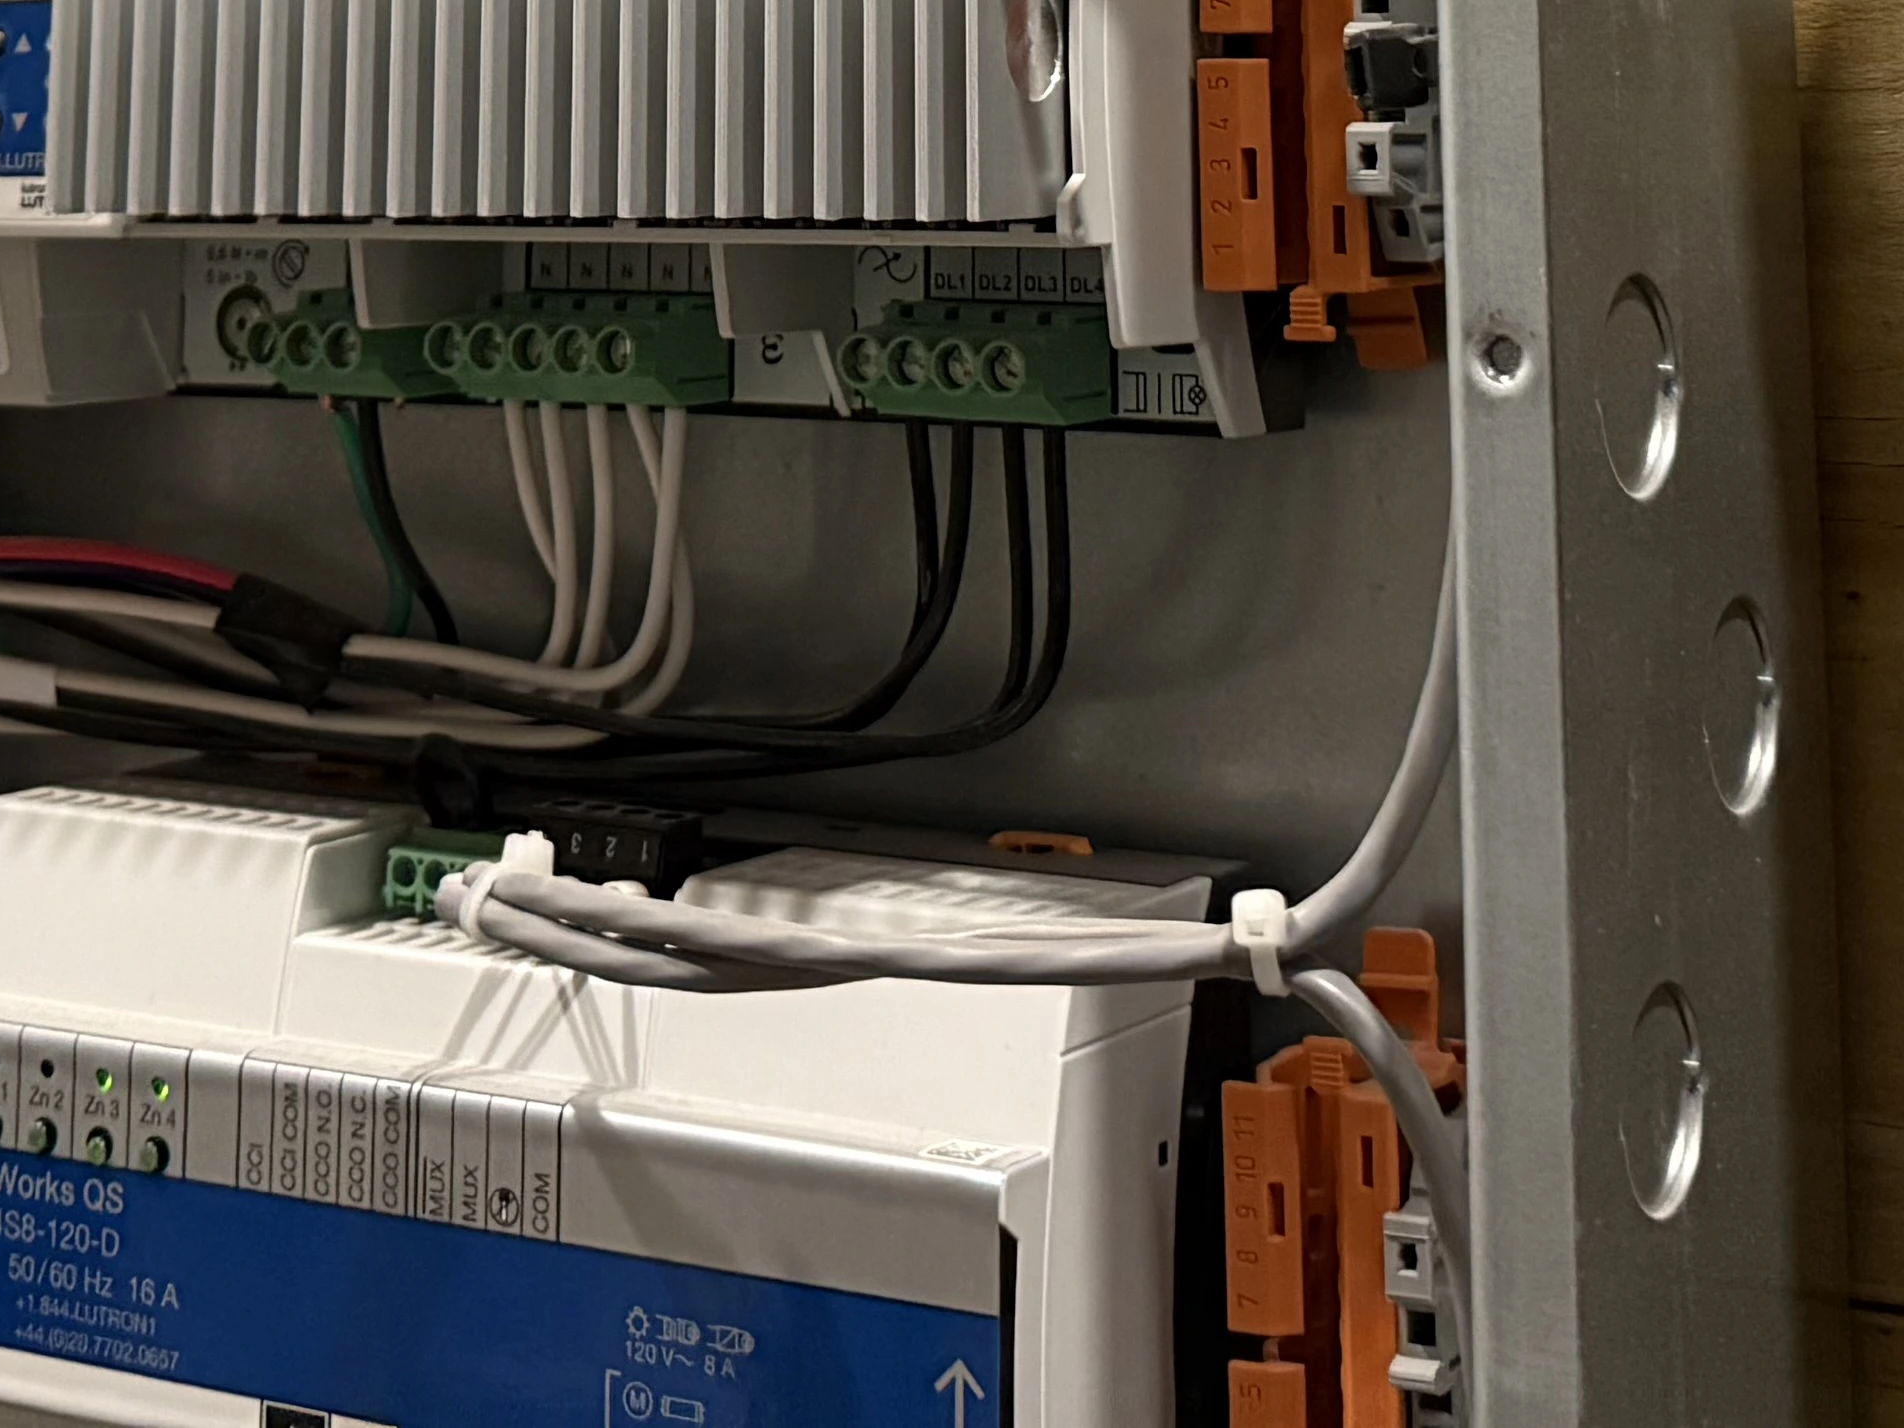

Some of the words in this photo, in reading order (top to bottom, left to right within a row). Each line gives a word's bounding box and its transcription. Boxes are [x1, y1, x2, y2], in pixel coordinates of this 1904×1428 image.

[935, 273, 965, 291] DL1
[979, 275, 1012, 291] DL2
[1024, 275, 1057, 293] DL3
[0, 1081, 9, 1099] 1
[29, 1086, 52, 1107] Zn
[53, 1090, 65, 1109] 2
[84, 1095, 108, 1117] Zn
[109, 1099, 120, 1119] 3
[317, 1084, 334, 1133] N.O.
[139, 1104, 164, 1127] Zn
[164, 1109, 177, 1128] 4
[283, 1082, 300, 1143] COM
[351, 1090, 368, 1140] N.C.
[384, 1084, 403, 1146] COM
[248, 1143, 264, 1186] CCI
[281, 1149, 297, 1192] CCI
[313, 1141, 331, 1197] CCO
[347, 1146, 365, 1204] CCO
[381, 1152, 399, 1209] CCO
[83, 1182, 124, 1215] QS
[429, 1160, 446, 1217] MUX
[462, 1165, 479, 1222] MUX
[533, 1173, 551, 1234] COM
[7, 1256, 77, 1291] 50/60
[83, 1269, 113, 1298] Hz
[129, 1278, 155, 1306] 16
[161, 1283, 179, 1310] A
[16, 1296, 157, 1336] +1.844.LUTRON1
[624, 1339, 656, 1365] 120
[704, 1352, 716, 1375] 8
[719, 1357, 737, 1381] A
